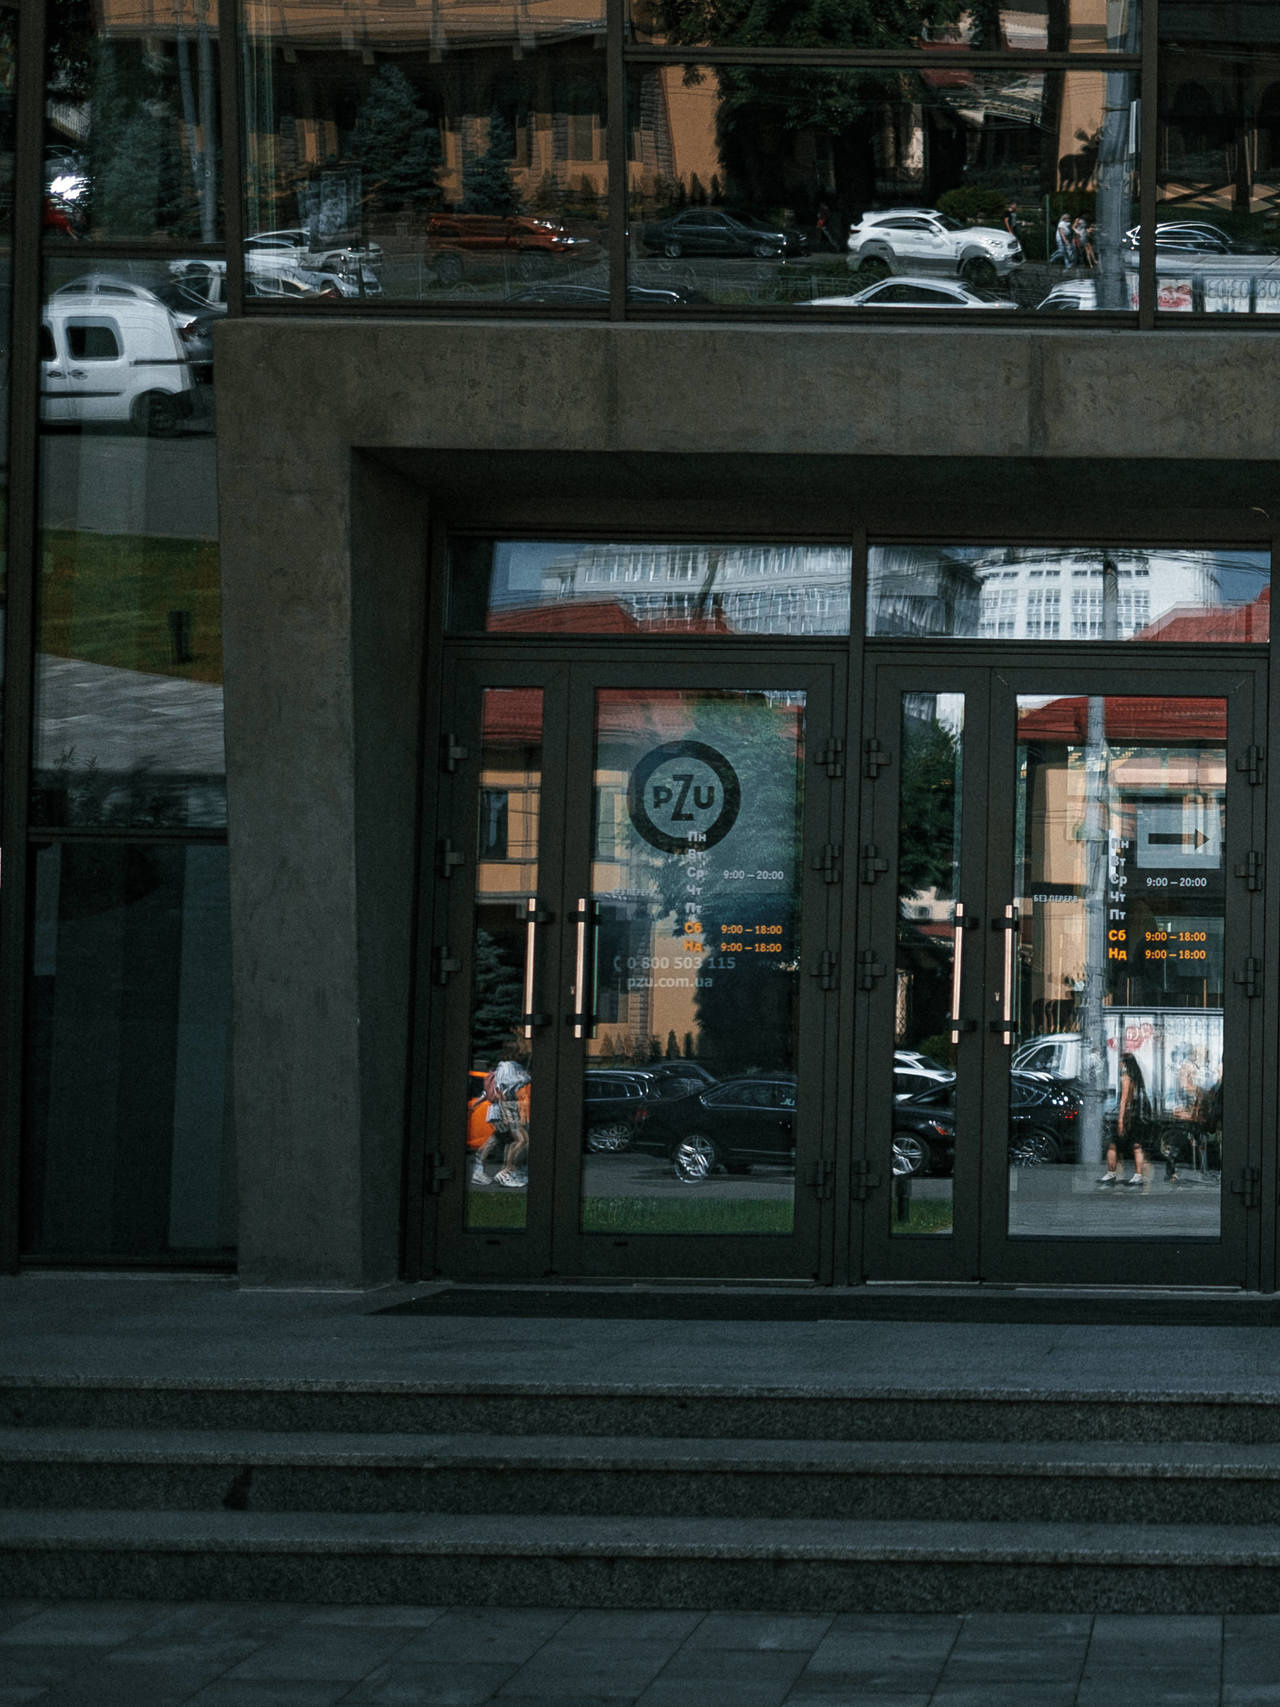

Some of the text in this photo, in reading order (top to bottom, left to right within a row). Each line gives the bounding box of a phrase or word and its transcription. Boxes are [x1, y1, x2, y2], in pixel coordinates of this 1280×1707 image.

[653, 774, 716, 822] PZU
[688, 831, 707, 843] Пн
[1111, 838, 1129, 849] Пн
[688, 849, 705, 860] Вт
[1111, 856, 1126, 867] Вт
[687, 867, 705, 881] Ср
[723, 870, 746, 880] 9:00
[756, 870, 784, 880] 20:00
[1110, 873, 1128, 887] Ср
[1146, 877, 1168, 887] 9:00
[1179, 877, 1207, 887] 20:00
[686, 885, 703, 896] Чт
[1110, 891, 1126, 902] Чт
[685, 902, 702, 914] Пт
[1109, 909, 1126, 920] Пт
[684, 922, 703, 934] Сб
[721, 924, 743, 935] 9:00
[755, 924, 782, 935] 18:00
[1108, 930, 1127, 941] Сб
[1145, 932, 1168, 942] 9:00
[1179, 932, 1207, 942] 18:00
[684, 940, 703, 952] Нд
[720, 942, 743, 952] 9:00
[755, 942, 782, 952] 18:00
[1108, 948, 1127, 960] Нд
[1145, 950, 1168, 960] 9:00
[1179, 950, 1207, 960] 18:00
[641, 957, 671, 969] 800
[674, 957, 703, 969] 503
[707, 957, 736, 969] 115
[627, 976, 713, 989] pzu.com.ua
